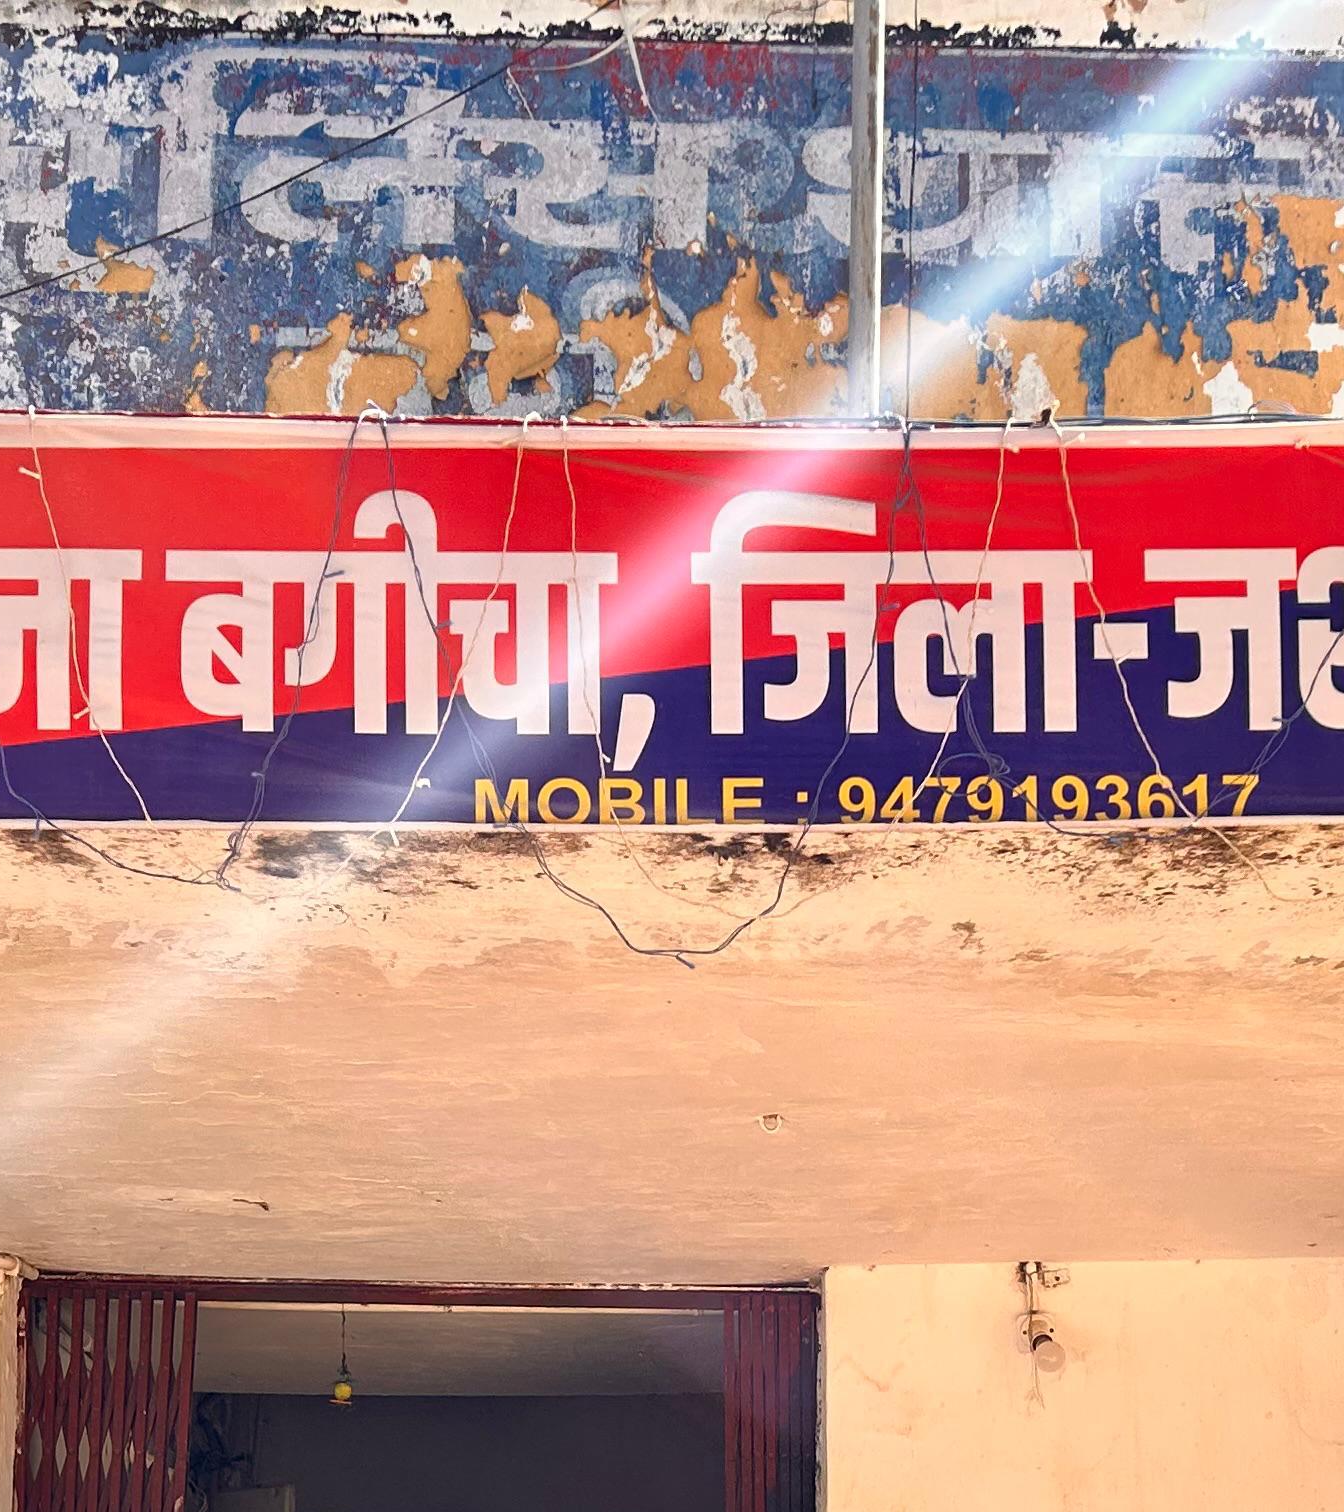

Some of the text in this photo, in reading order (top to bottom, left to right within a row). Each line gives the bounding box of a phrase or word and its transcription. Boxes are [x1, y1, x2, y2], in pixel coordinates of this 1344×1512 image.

[166, 490, 656, 772] बगीचा,
[474, 777, 765, 825] MOBILE
[839, 772, 1261, 825] 9479193617
